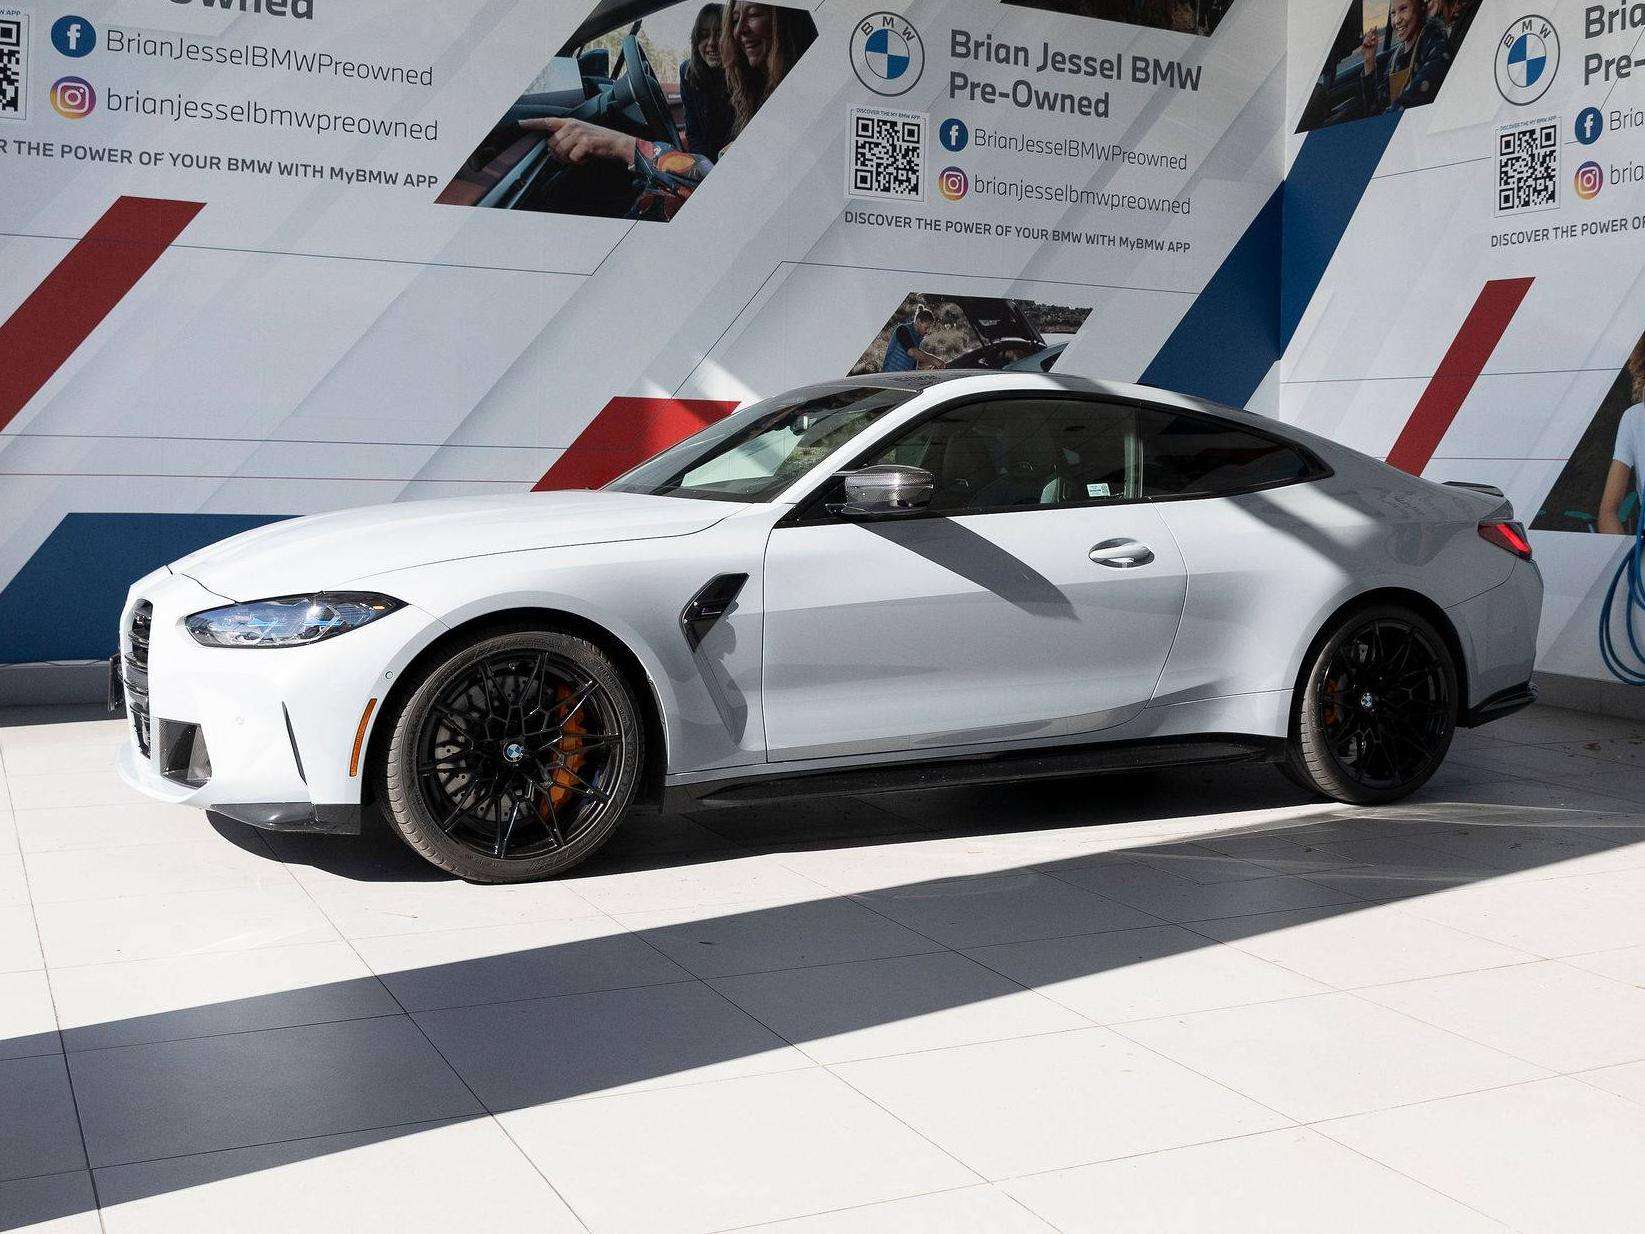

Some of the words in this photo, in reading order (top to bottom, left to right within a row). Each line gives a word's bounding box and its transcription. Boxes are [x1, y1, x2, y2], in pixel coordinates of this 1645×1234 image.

[861, 16, 916, 42] BMW
[1504, 20, 1551, 48] BMW
[1585, 0, 1645, 39] Bria
[107, 30, 433, 86] BrianJesselBMWPreowned
[950, 29, 1029, 67] Brian
[1036, 42, 1122, 80] Jessel
[1131, 55, 1202, 91] BMW
[1584, 53, 1645, 86] Pre-
[107, 88, 439, 142] brianjesselbmwpreowned
[949, 71, 1109, 118] Pre-Owned
[1610, 107, 1644, 131] Bria
[13, 140, 54, 157] THE
[61, 144, 133, 164] POWER
[139, 151, 164, 166] OF
[170, 152, 221, 171] YOUR
[227, 157, 273, 174] BMW
[278, 161, 324, 179] WITH
[330, 166, 399, 185] MyBMW
[403, 173, 438, 188] APP
[974, 128, 1187, 170] BrianJesselBMWPreowned
[1610, 161, 1644, 185] bria
[974, 174, 1191, 215] brianjesselbmwpreowned
[844, 211, 912, 229] DISCOVER
[915, 217, 942, 232] THE
[945, 220, 992, 236] POWER
[995, 225, 1012, 237] OF
[1015, 226, 1049, 241] YOUR
[1052, 230, 1082, 244] BMW
[1085, 232, 1116, 247] WITH
[1119, 236, 1164, 251] MyBMW
[1167, 241, 1191, 253] APP
[1491, 228, 1549, 248] DISCOVER
[1553, 224, 1578, 240] THE
[1581, 218, 1628, 236] POWER
